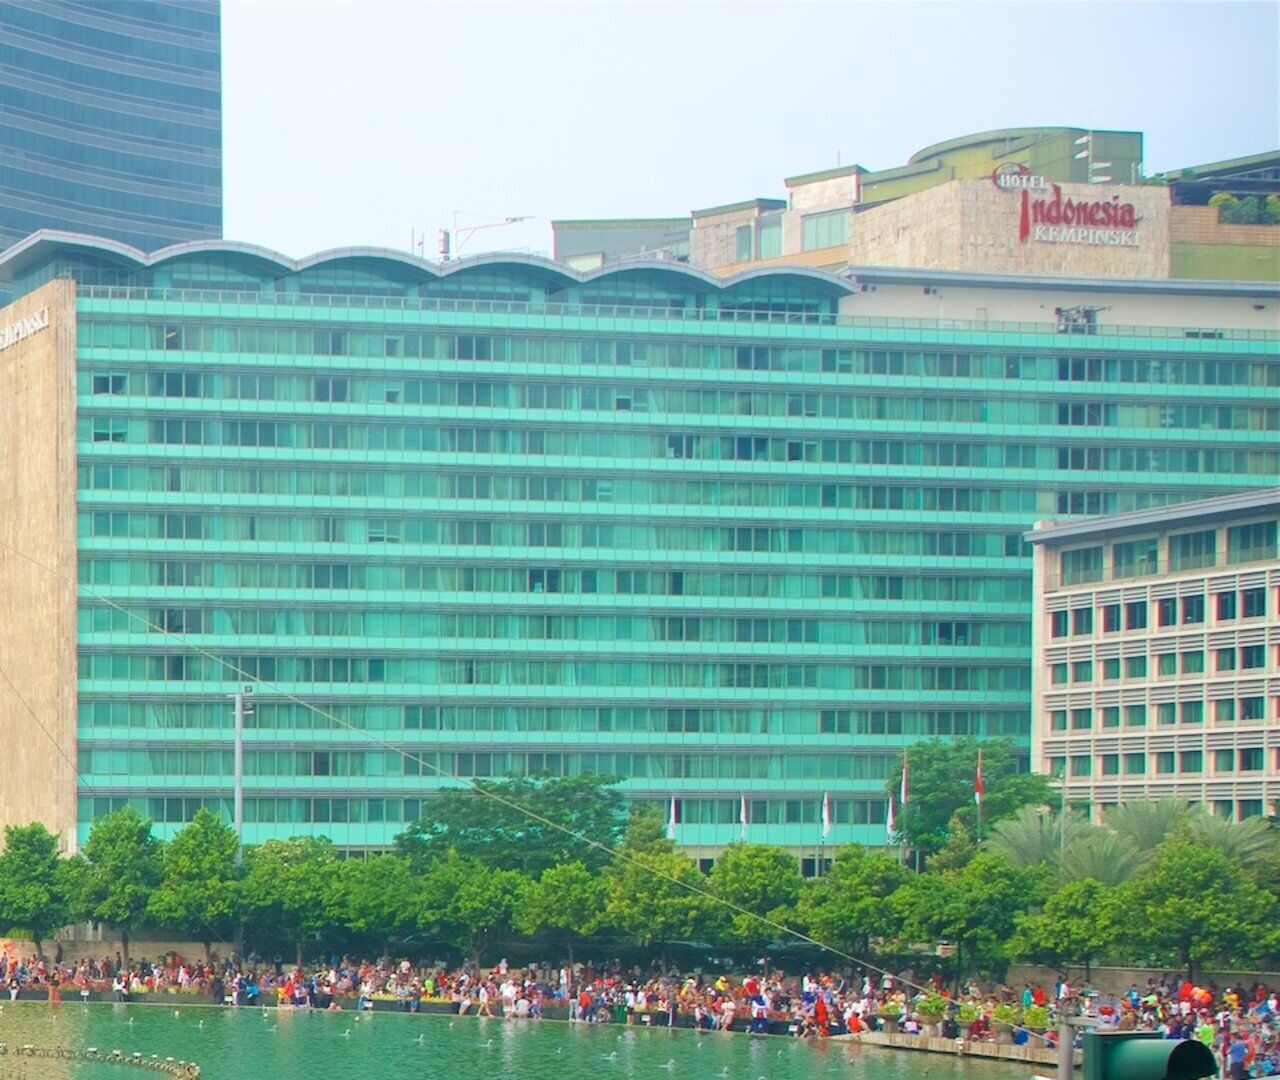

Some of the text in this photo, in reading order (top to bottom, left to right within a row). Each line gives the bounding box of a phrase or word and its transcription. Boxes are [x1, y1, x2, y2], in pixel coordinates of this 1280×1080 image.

[999, 173, 1048, 191] HOTEL
[1019, 183, 1143, 244] Indonesia
[1033, 226, 1140, 247] KEMPINSKI
